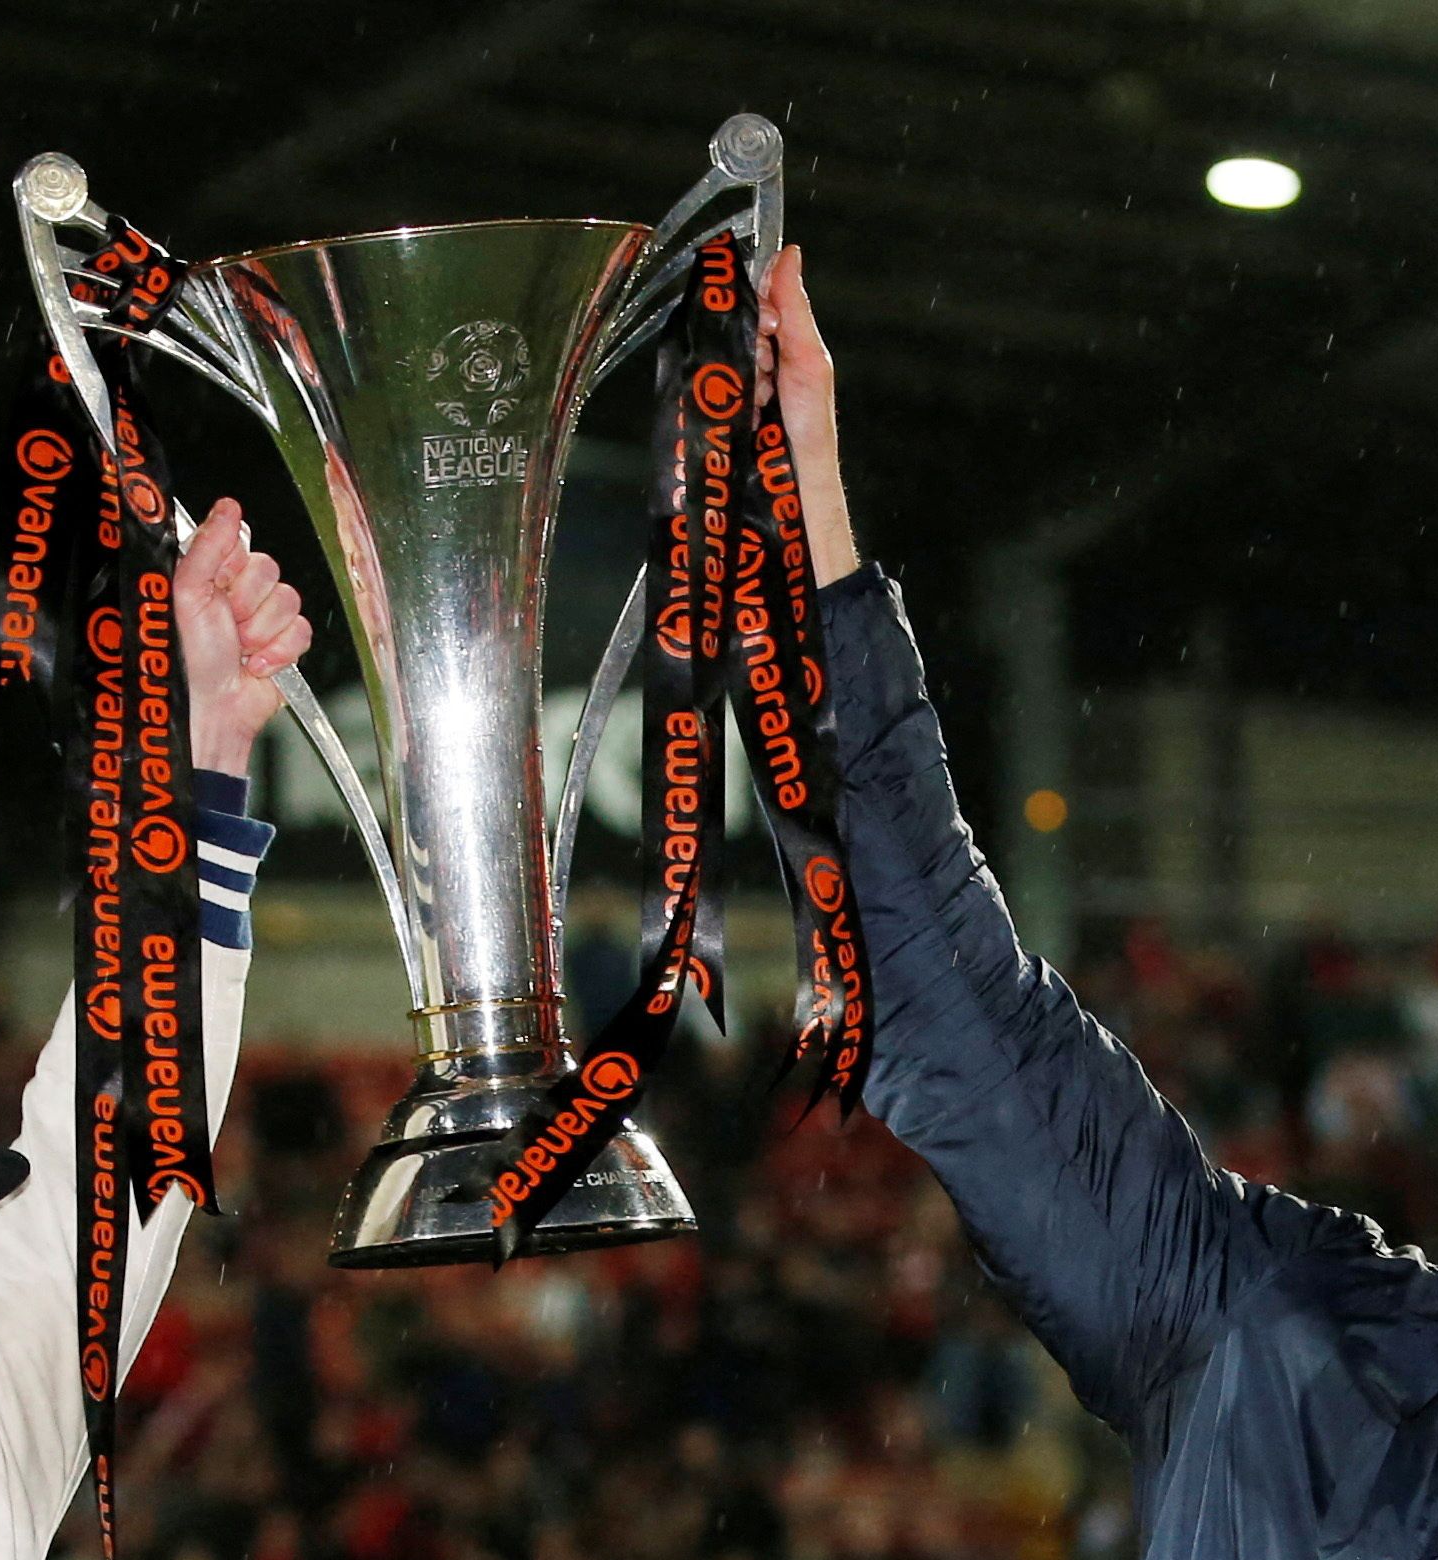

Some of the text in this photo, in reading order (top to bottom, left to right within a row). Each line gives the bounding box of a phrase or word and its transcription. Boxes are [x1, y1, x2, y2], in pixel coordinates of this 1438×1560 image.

[422, 436, 529, 460] NATIONAL
[423, 454, 528, 484] LEAGUE
[702, 424, 731, 659] vanarama
[87, 668, 124, 877] vanaram
[138, 572, 174, 812] vanarama
[735, 579, 808, 809] vanarama
[141, 933, 187, 1168] vanarama
[87, 1093, 115, 1338] vanarama
